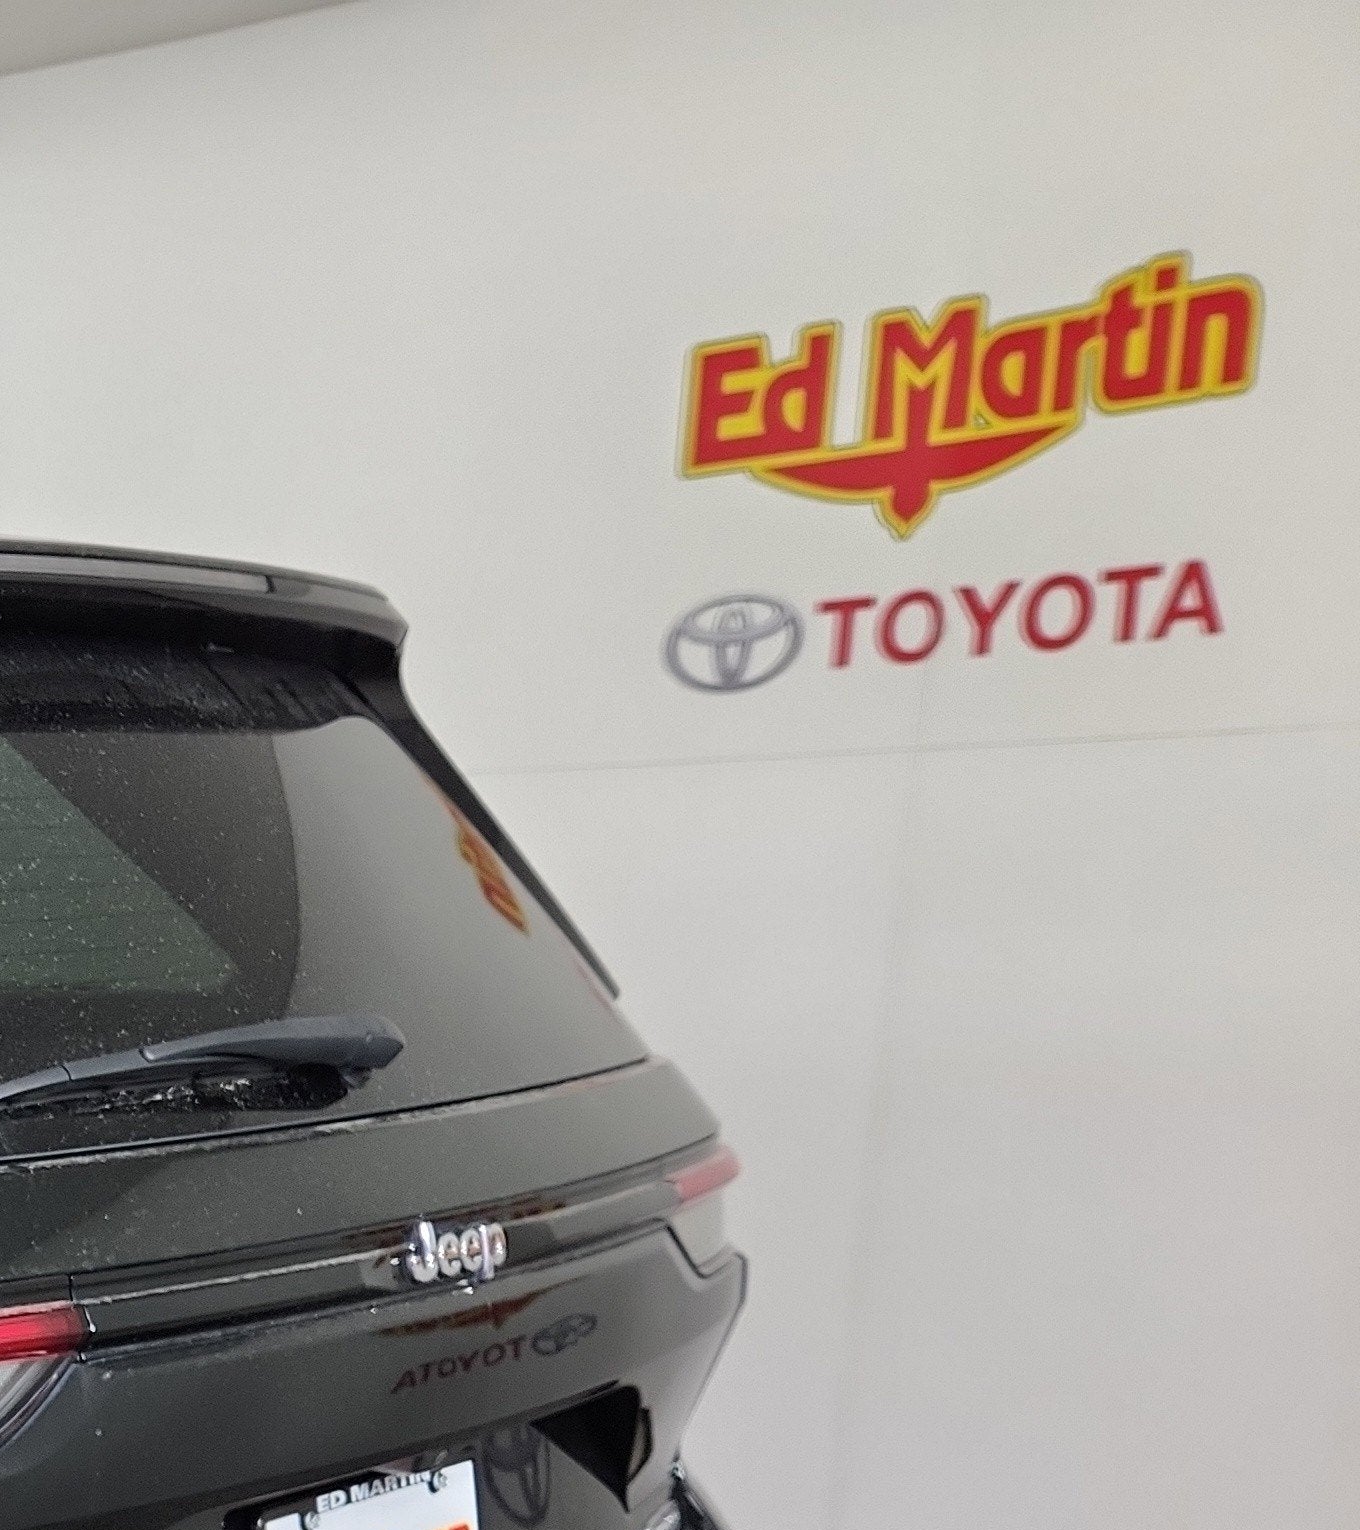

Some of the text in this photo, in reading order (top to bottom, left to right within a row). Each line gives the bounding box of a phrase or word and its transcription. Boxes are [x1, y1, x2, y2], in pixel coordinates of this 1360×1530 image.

[680, 250, 1264, 482] Ed Martin
[816, 559, 1224, 669] TOYOTA
[405, 1220, 507, 1283] Jeep
[315, 1489, 349, 1514] ED
